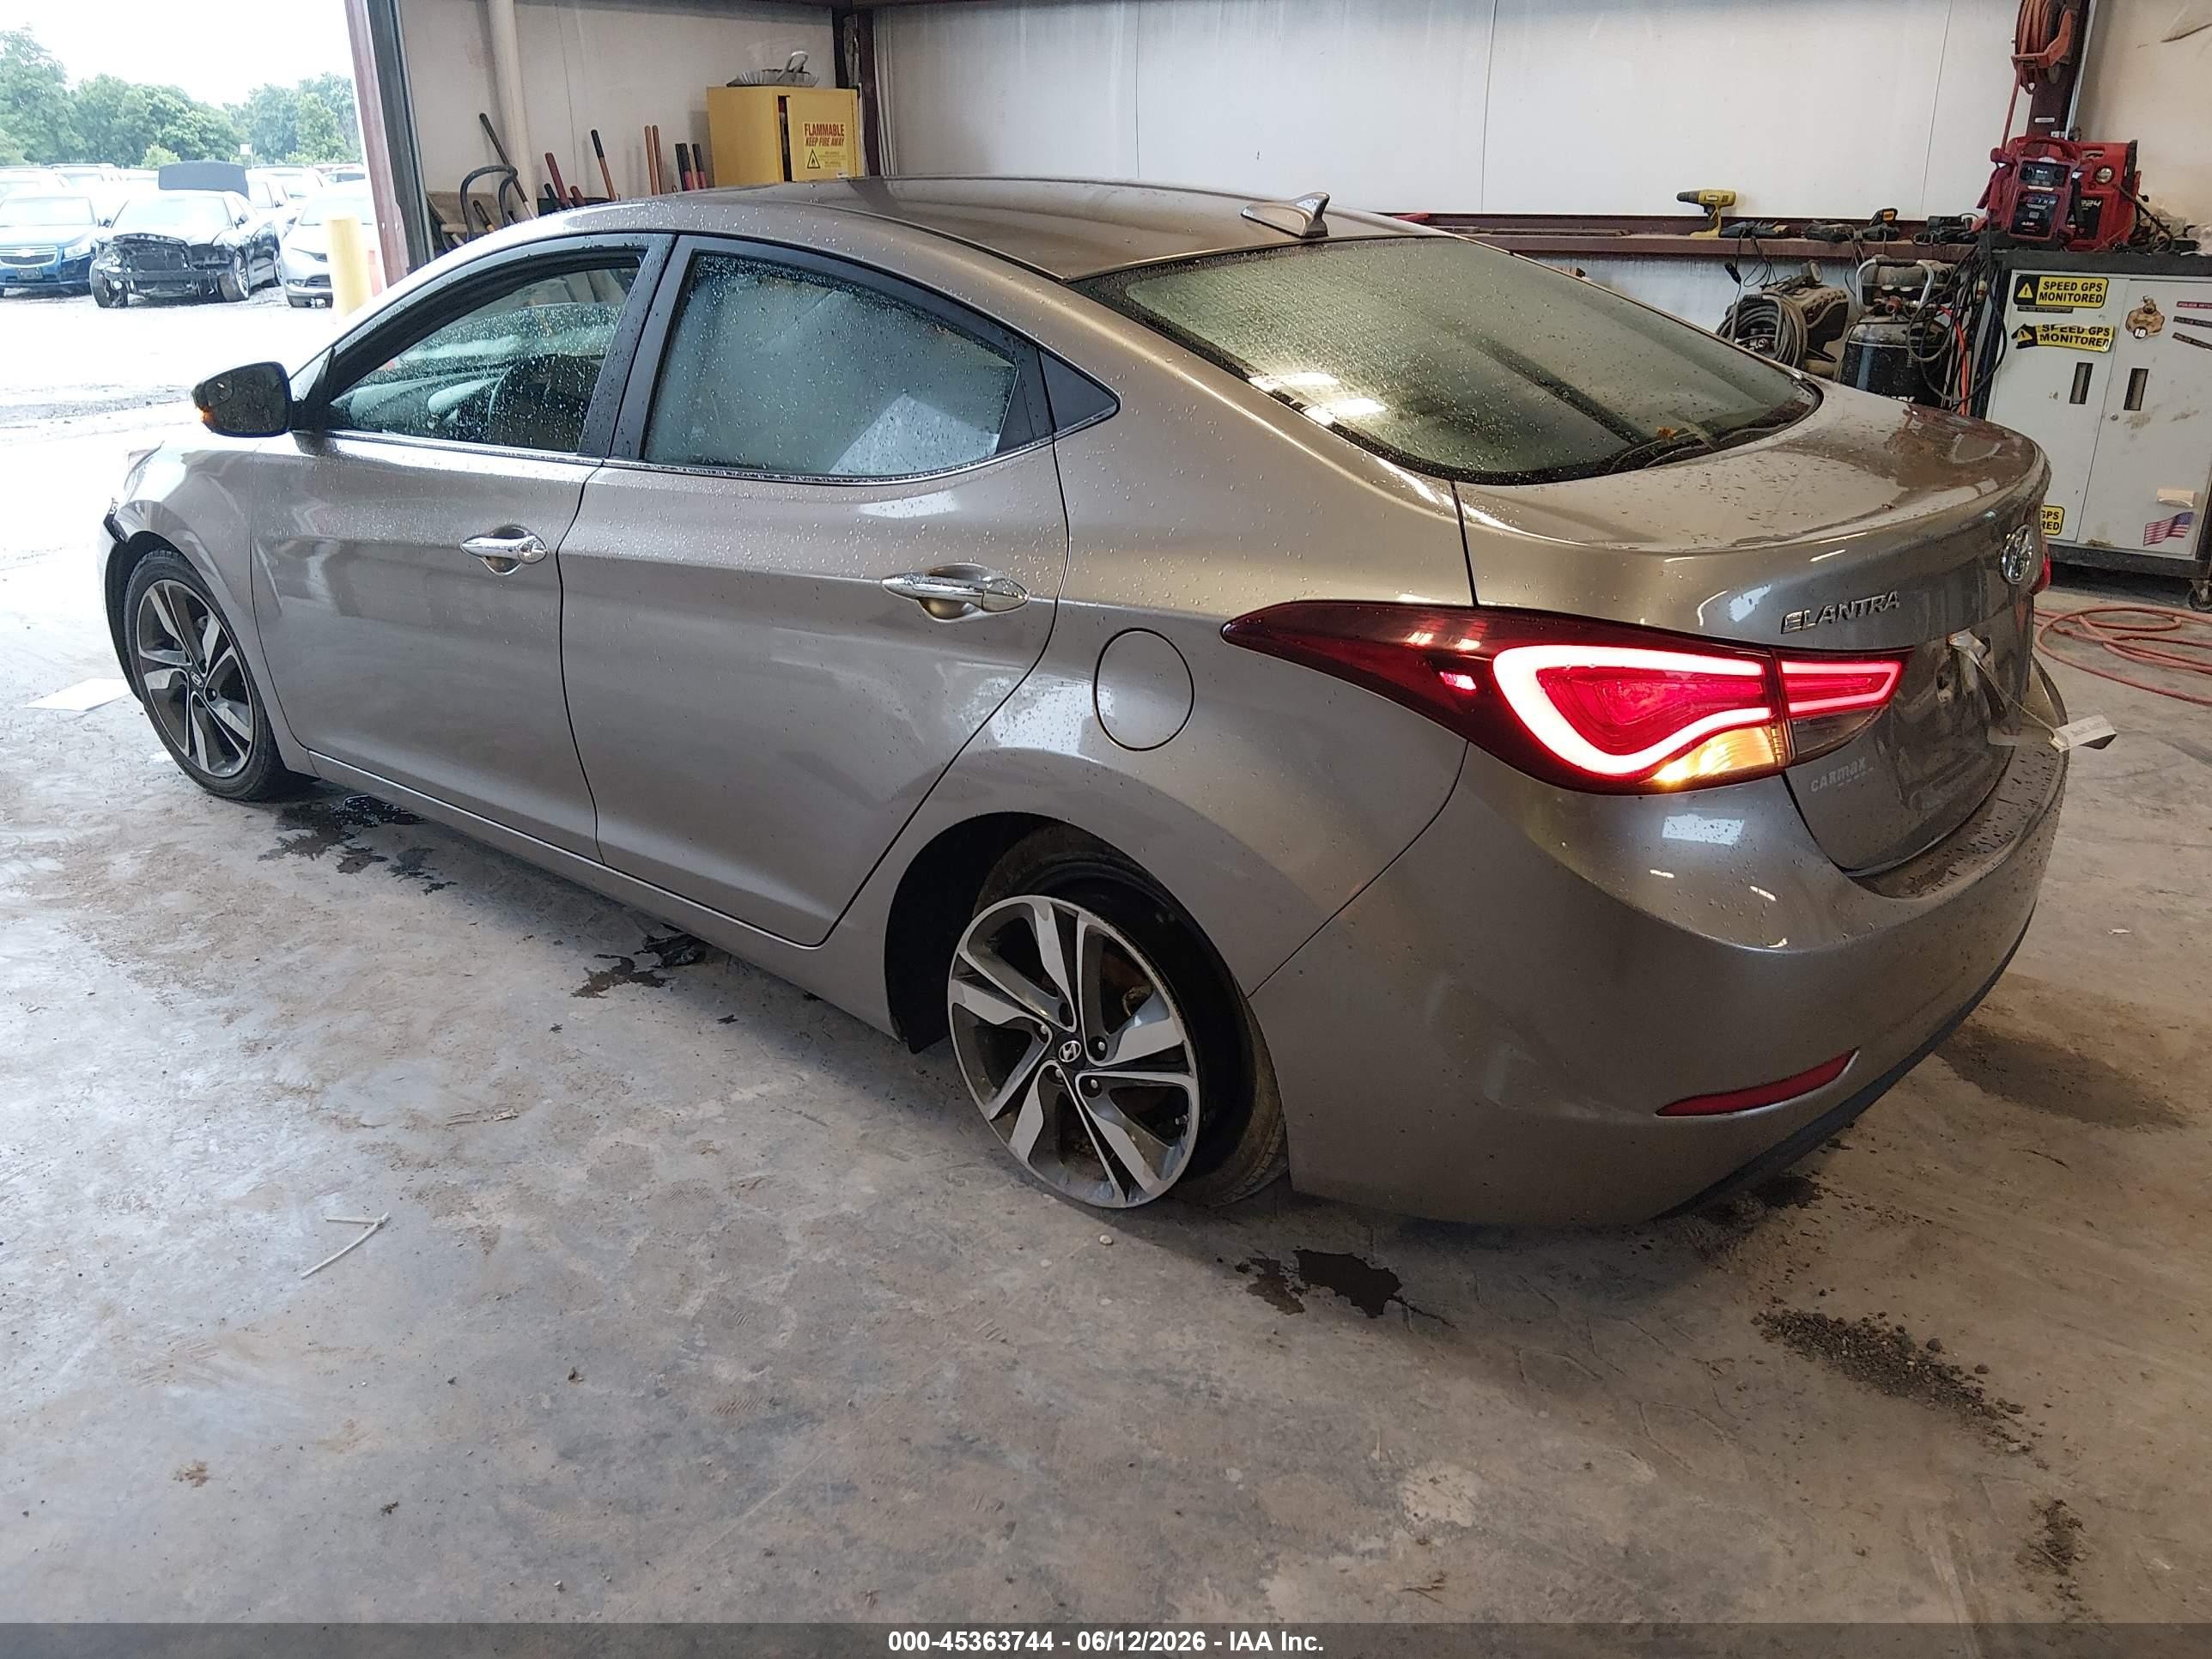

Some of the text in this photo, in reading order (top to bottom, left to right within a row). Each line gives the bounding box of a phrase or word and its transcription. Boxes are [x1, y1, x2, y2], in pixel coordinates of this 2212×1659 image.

[805, 124, 844, 137] FLAMMABLE
[805, 137, 845, 147] KEEP FIRE AWAY
[2043, 281, 2103, 293] SPEED GPS
[2039, 292, 2103, 304] MONITORED
[2088, 326, 2111, 337] GPS
[2039, 333, 2110, 349] MONITORED
[1780, 590, 1900, 635] ELANTRA
